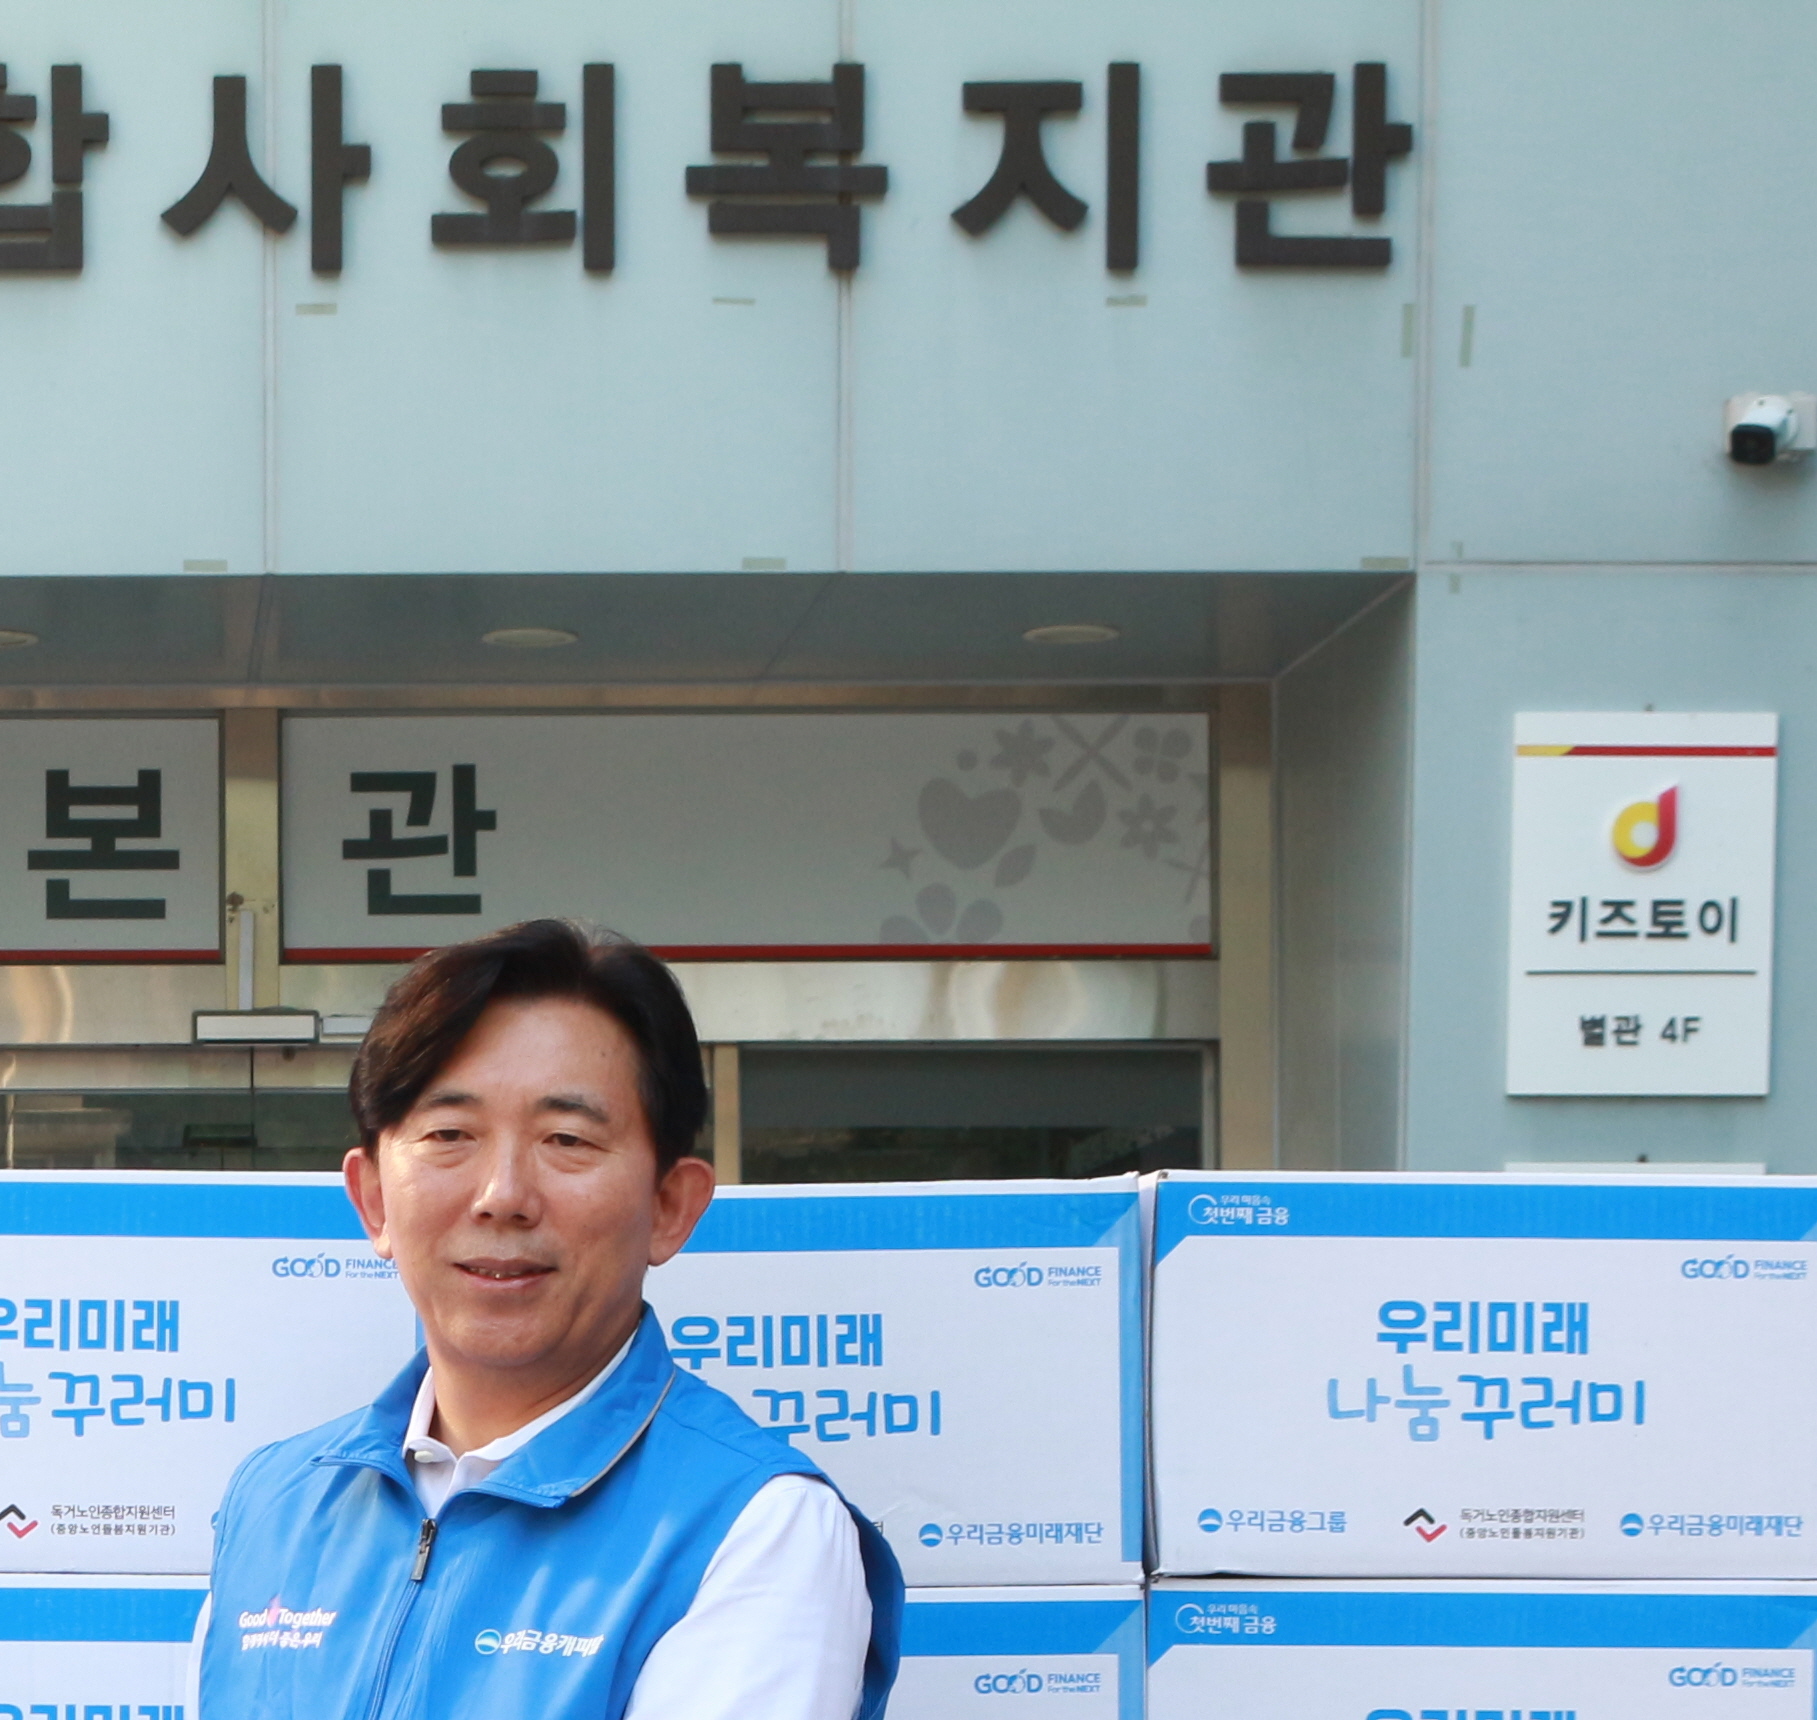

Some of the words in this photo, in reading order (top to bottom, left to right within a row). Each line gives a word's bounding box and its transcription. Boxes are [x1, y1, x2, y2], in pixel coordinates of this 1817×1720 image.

[1547, 897, 1738, 944] 키즈토이
[1579, 1014, 1643, 1047] 별관
[1661, 1017, 1700, 1042] 4F
[1203, 1205, 1253, 1225] 첫번째
[1257, 1206, 1290, 1225] 금융
[272, 1253, 340, 1278] GOOD
[974, 1262, 1043, 1288] GOOD
[1048, 1266, 1102, 1277] FINANCE
[1681, 1255, 1750, 1279] GOOD
[1377, 1301, 1588, 1355] 우리미래
[671, 1313, 883, 1370] 우리미래
[52, 1504, 176, 1520] 독거노인종합지원센터
[1226, 1510, 1347, 1534] 우리금융그룹
[947, 1522, 1104, 1545] 우리금융미래재단
[1648, 1514, 1804, 1537] 우리금융미래재단
[239, 1608, 267, 1628] Good
[278, 1607, 337, 1629] Together
[1190, 1615, 1240, 1634] 첫번째
[1243, 1616, 1276, 1635] 금융
[974, 1669, 1043, 1694] GOOD
[1047, 1673, 1101, 1684] FINANCE
[1670, 1663, 1738, 1687] GOOD
